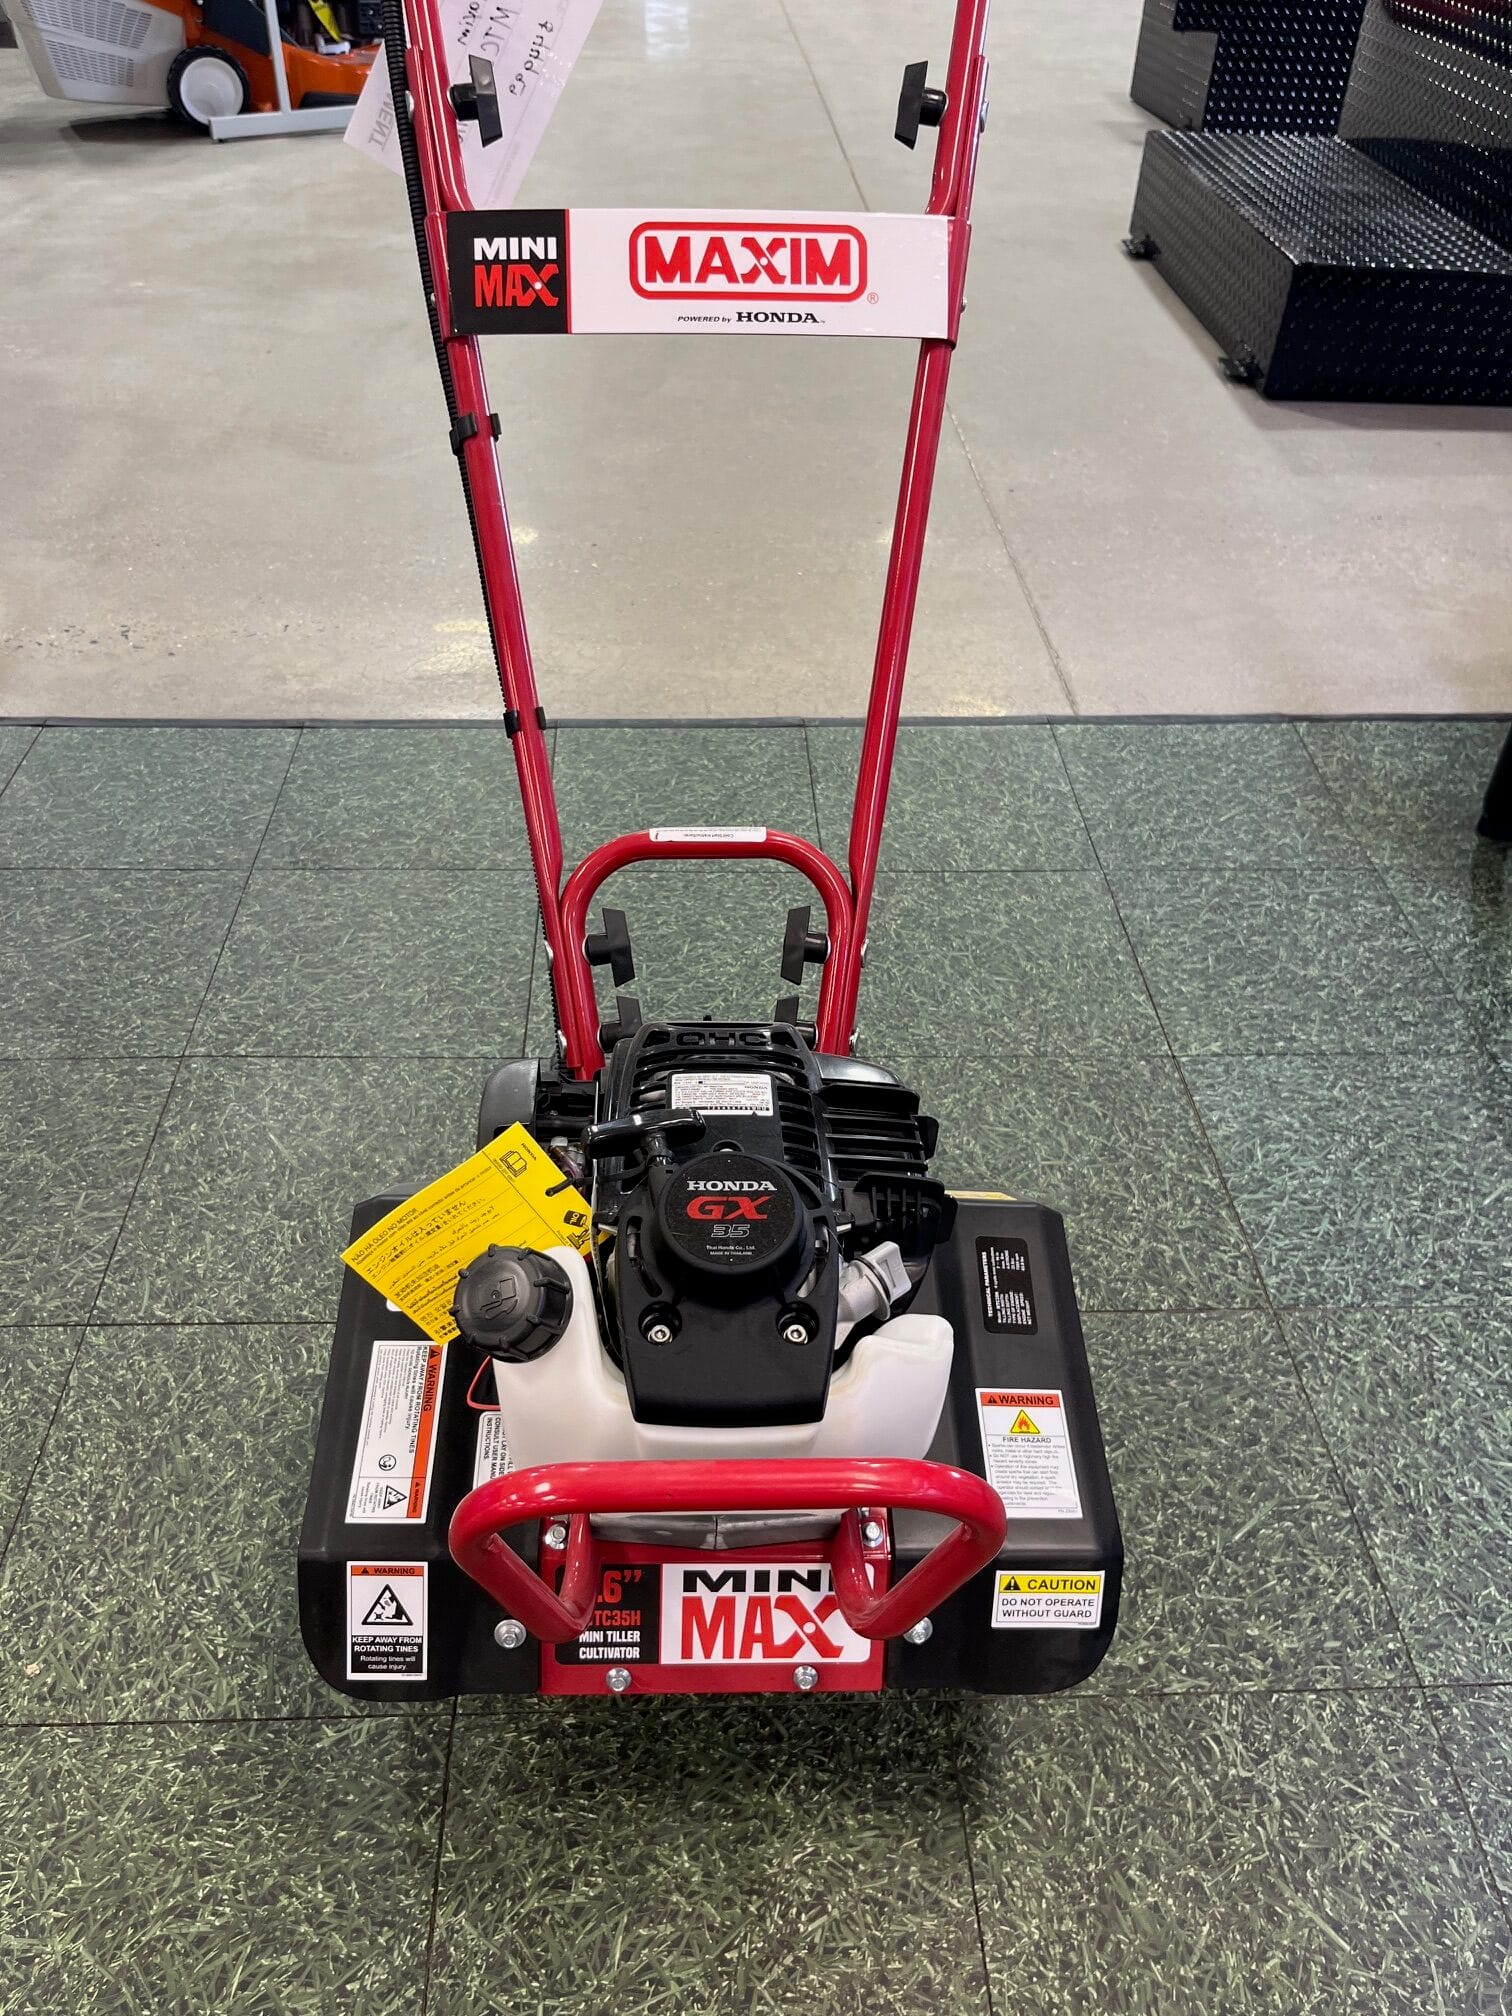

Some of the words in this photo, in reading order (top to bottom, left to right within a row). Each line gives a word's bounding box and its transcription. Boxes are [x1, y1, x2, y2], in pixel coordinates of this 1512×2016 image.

[473, 237, 557, 260] MINI
[644, 236, 852, 286] MAXIM
[474, 264, 559, 308] MAX
[677, 315, 720, 323] POWERED
[721, 315, 732, 324] by
[736, 311, 819, 323] HONDA
[687, 1180, 778, 1191] HONDA
[686, 1195, 774, 1221] GX
[387, 1222, 398, 1233] NO
[396, 1207, 418, 1226] MOTOR
[711, 1224, 751, 1238] 35
[413, 1347, 421, 1369] Rotating
[423, 1365, 437, 1412] WARNING
[999, 1395, 1054, 1405] WARNING
[411, 1401, 420, 1433] ROTATING
[493, 1417, 501, 1443] CONSULT
[408, 1435, 416, 1454] TINES
[500, 1452, 506, 1461] ON
[373, 1567, 415, 1575] WARNING
[683, 1570, 835, 1593] MIN
[1027, 1579, 1096, 1591] CAUTION
[1001, 1598, 1017, 1606] DO
[1019, 1598, 1043, 1606] NOT
[1045, 1598, 1095, 1607] OPERATE
[588, 1610, 641, 1626] TC35H
[1002, 1609, 1051, 1617] WITHOUT
[1053, 1609, 1092, 1618] GUARD
[681, 1595, 845, 1659] MAX
[579, 1630, 604, 1643] MINI
[606, 1630, 641, 1643] TILLER
[360, 1655, 387, 1663] Rotating
[579, 1646, 640, 1659] CULTIVATOR
